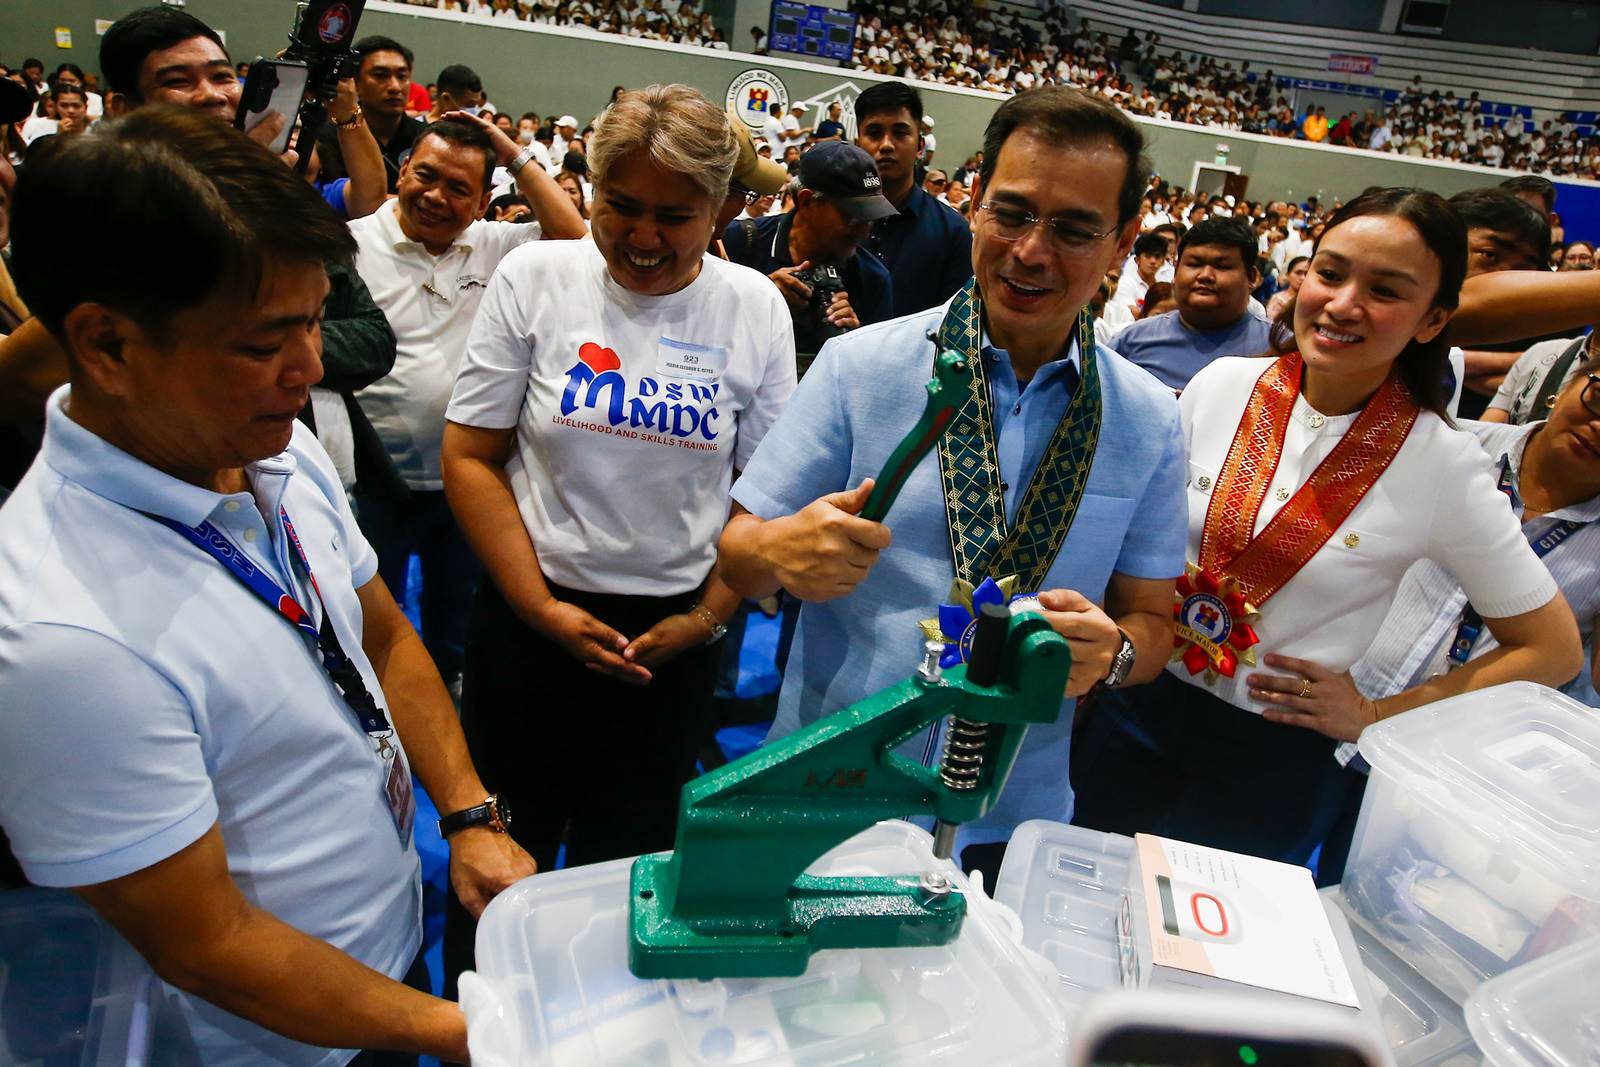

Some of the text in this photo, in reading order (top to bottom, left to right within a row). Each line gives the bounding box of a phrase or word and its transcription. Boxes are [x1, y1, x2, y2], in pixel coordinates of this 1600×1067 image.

[684, 354, 699, 364] 923
[552, 415, 718, 451] LIVELIHOOD AND SKILLS TRAINING
[1540, 526, 1568, 549] CITY
[1176, 625, 1218, 655] VICE MAYOR
